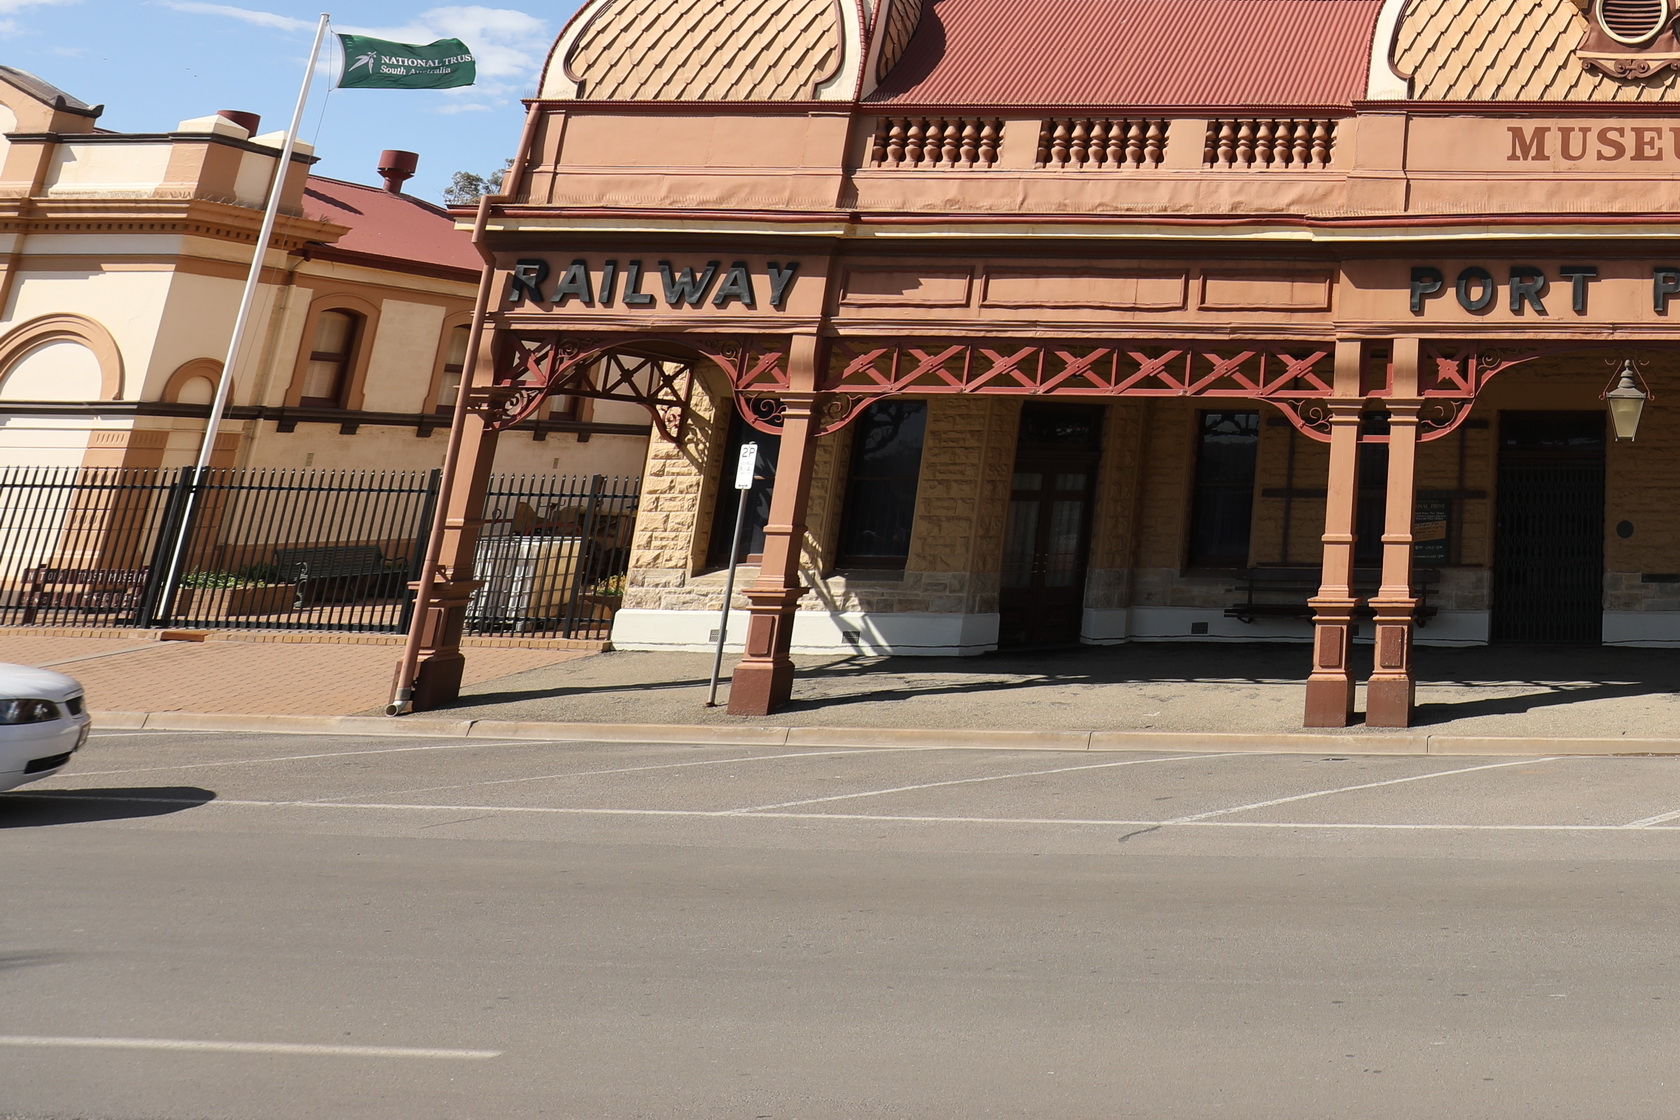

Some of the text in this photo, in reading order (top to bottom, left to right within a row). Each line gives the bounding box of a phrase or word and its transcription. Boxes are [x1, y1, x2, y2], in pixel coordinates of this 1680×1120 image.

[381, 55, 442, 67] NATIONAL
[380, 65, 406, 75] South
[508, 258, 801, 306] RAILWAY
[1410, 266, 1597, 312] PORT
[742, 447, 756, 458] 2P
